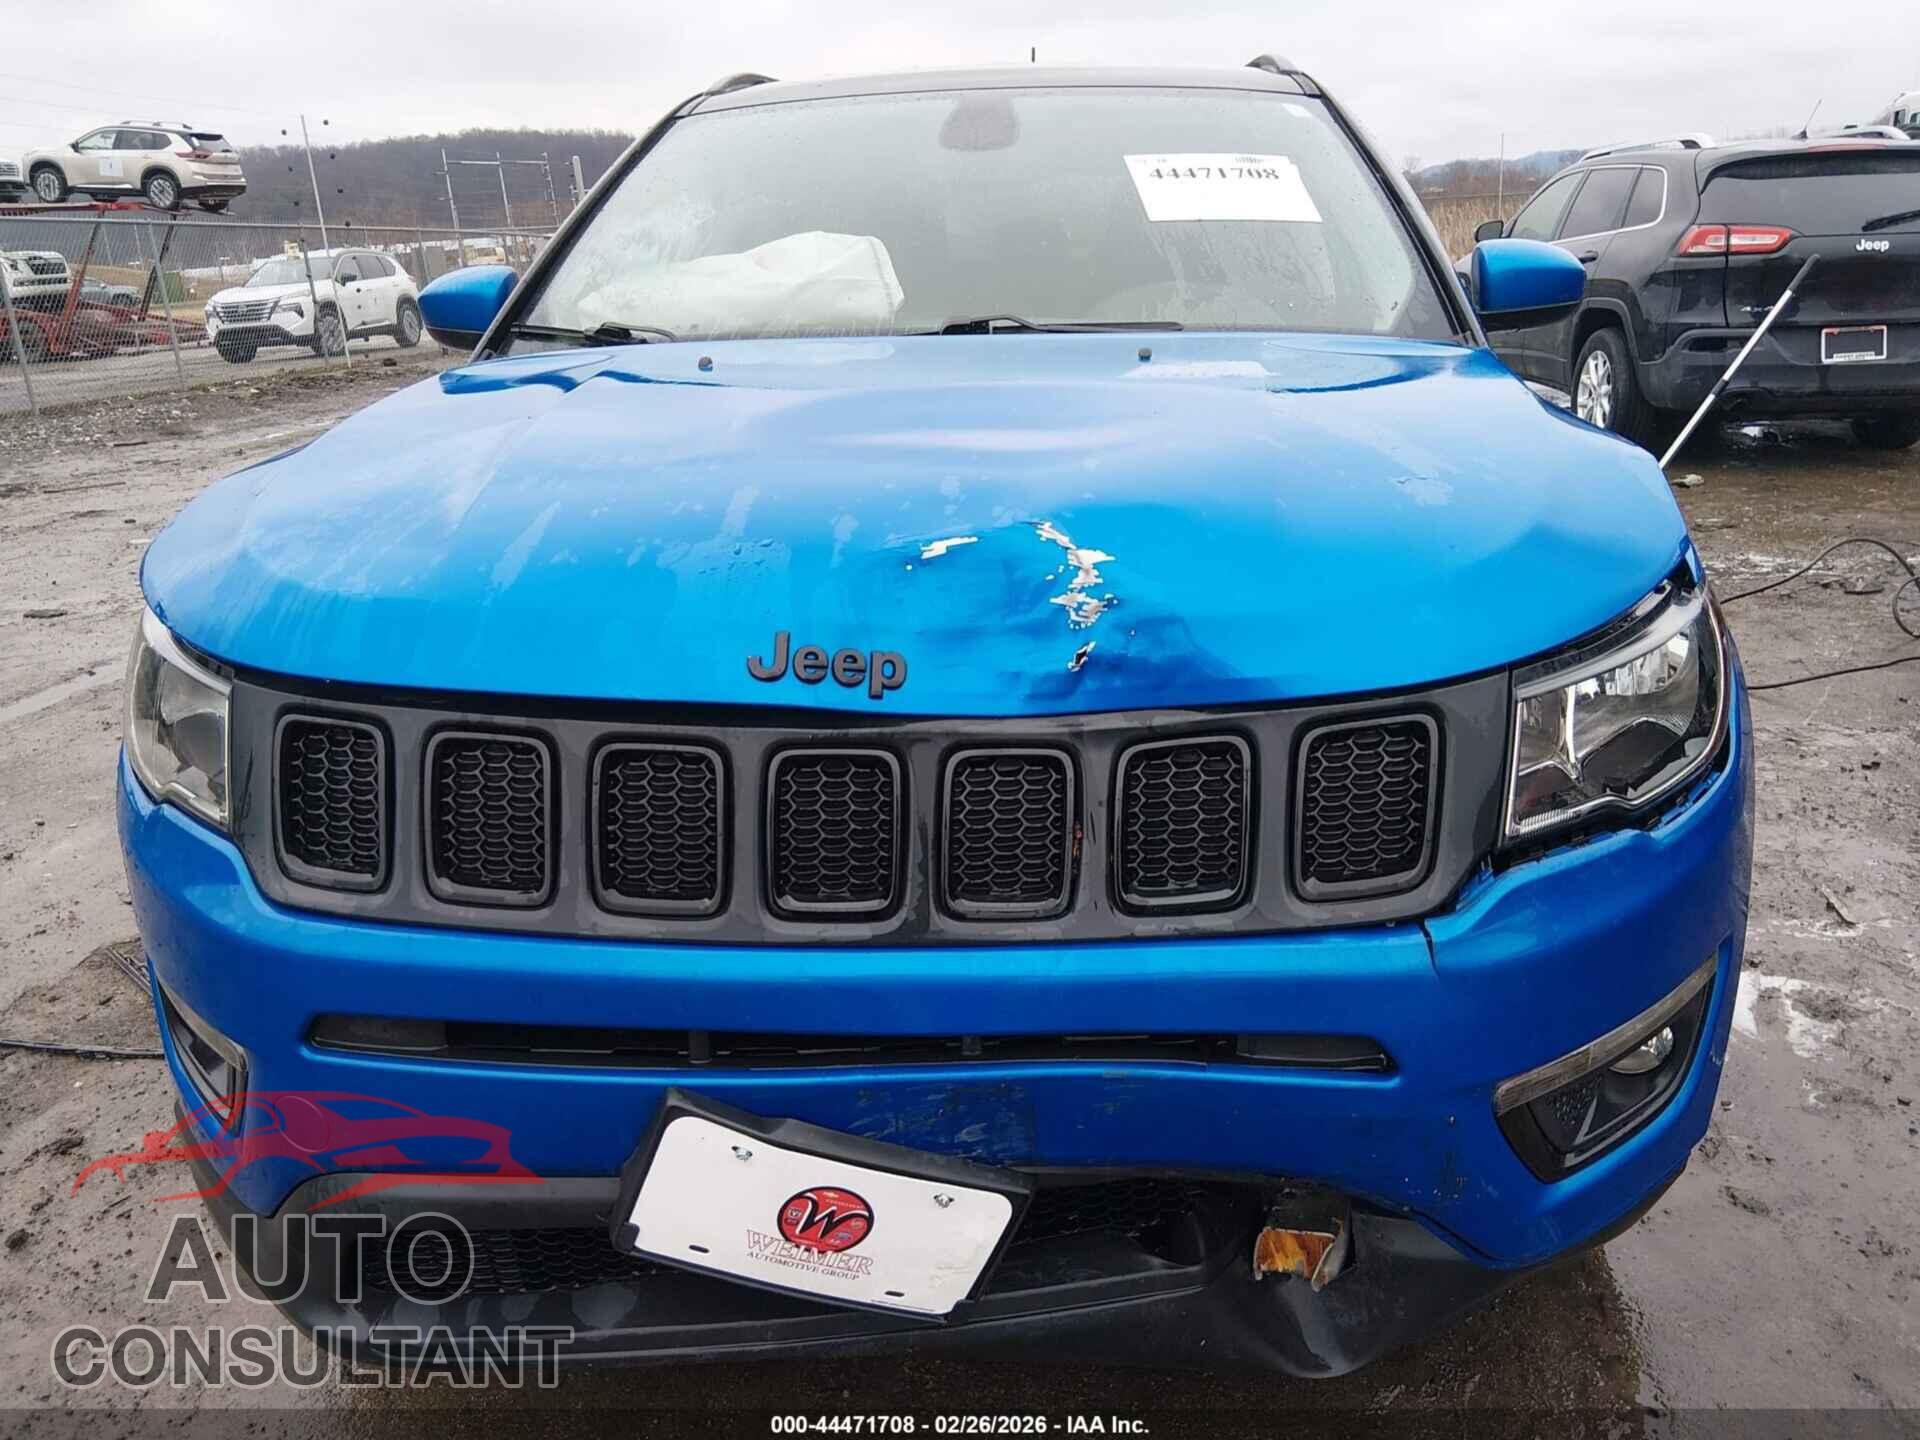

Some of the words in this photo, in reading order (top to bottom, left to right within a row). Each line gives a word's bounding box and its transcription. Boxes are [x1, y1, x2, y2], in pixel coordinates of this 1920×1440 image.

[1150, 167, 1280, 179] 44471708
[1855, 238, 1890, 252] Jeep
[747, 631, 907, 700] Jeep
[747, 1229, 874, 1276] WEIMER
[747, 1250, 819, 1273] AUTOMOTIVE
[821, 1267, 860, 1281] GROUP
